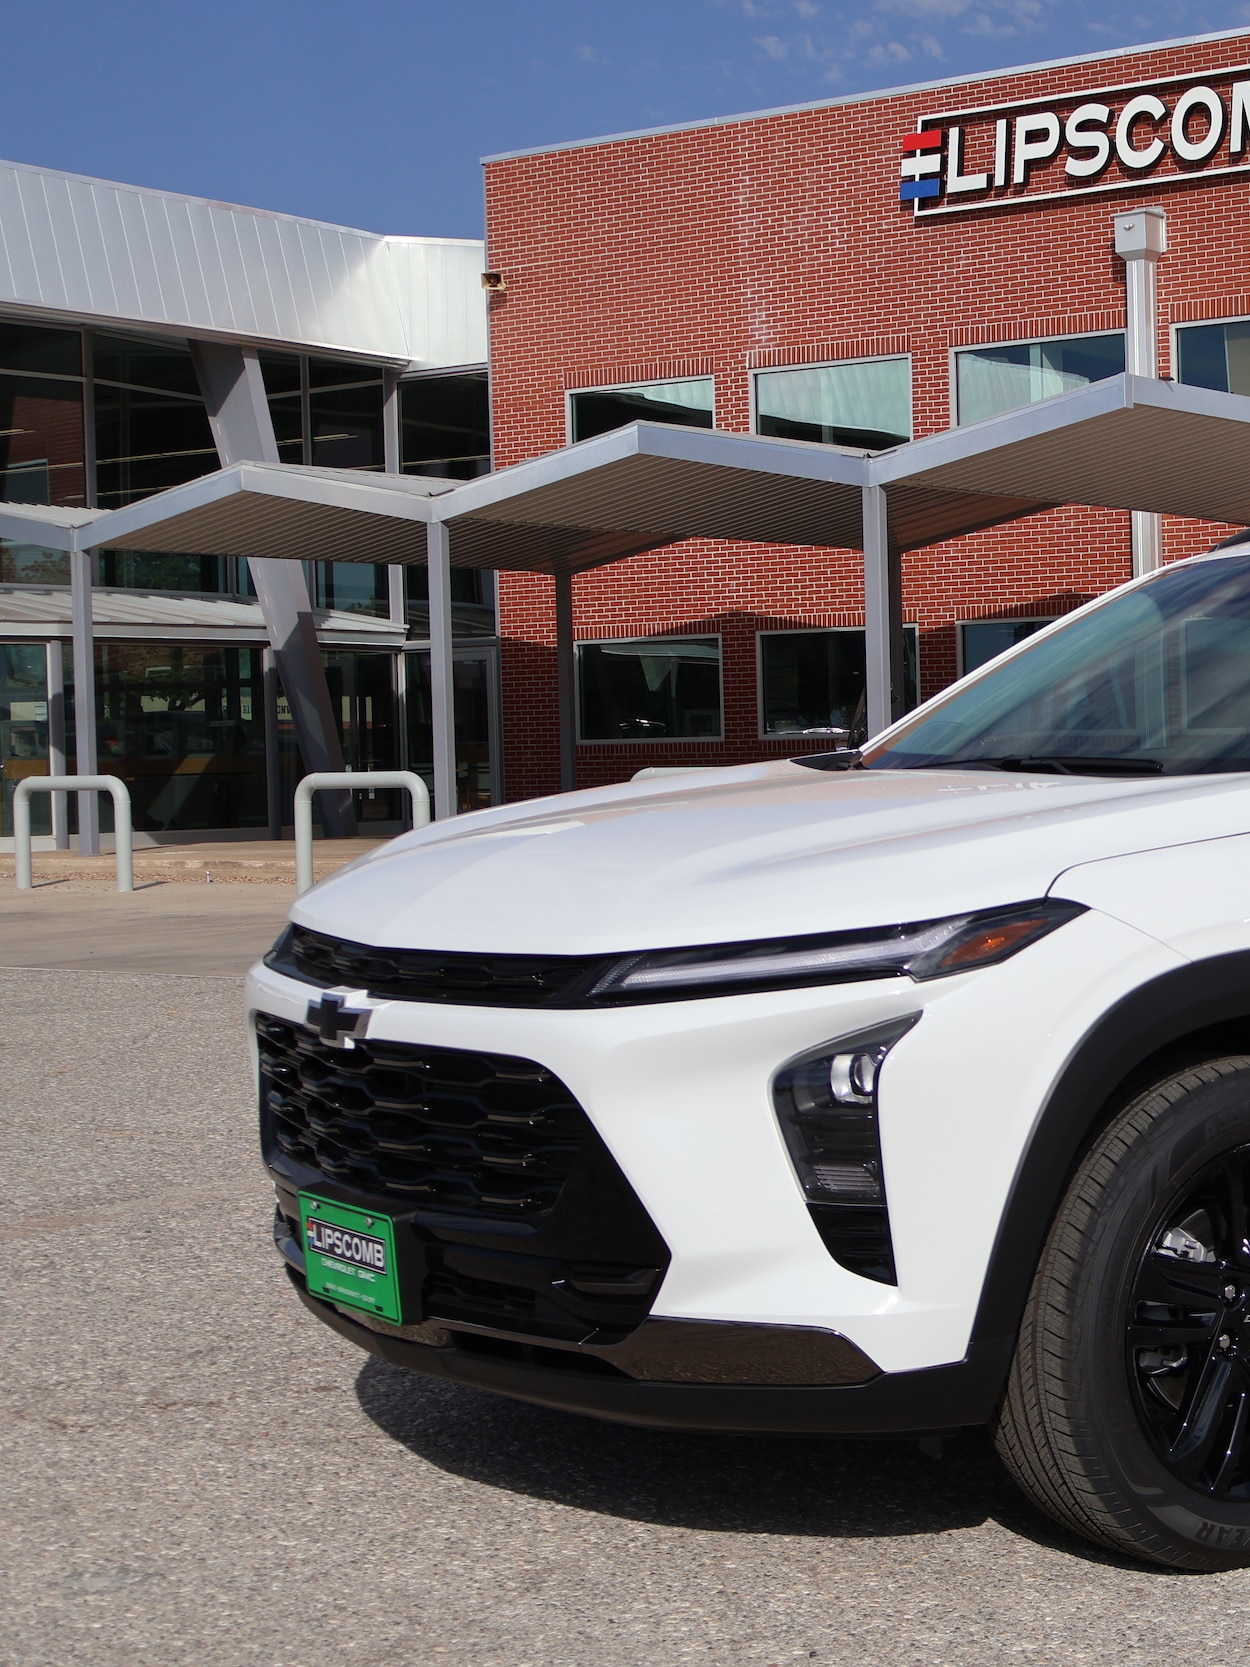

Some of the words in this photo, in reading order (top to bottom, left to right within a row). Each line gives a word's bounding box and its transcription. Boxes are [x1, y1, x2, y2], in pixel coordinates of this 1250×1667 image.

[313, 1223, 384, 1268] LIPSCOMB
[321, 1257, 355, 1276] CHEVROLET
[357, 1269, 377, 1283] GMC
